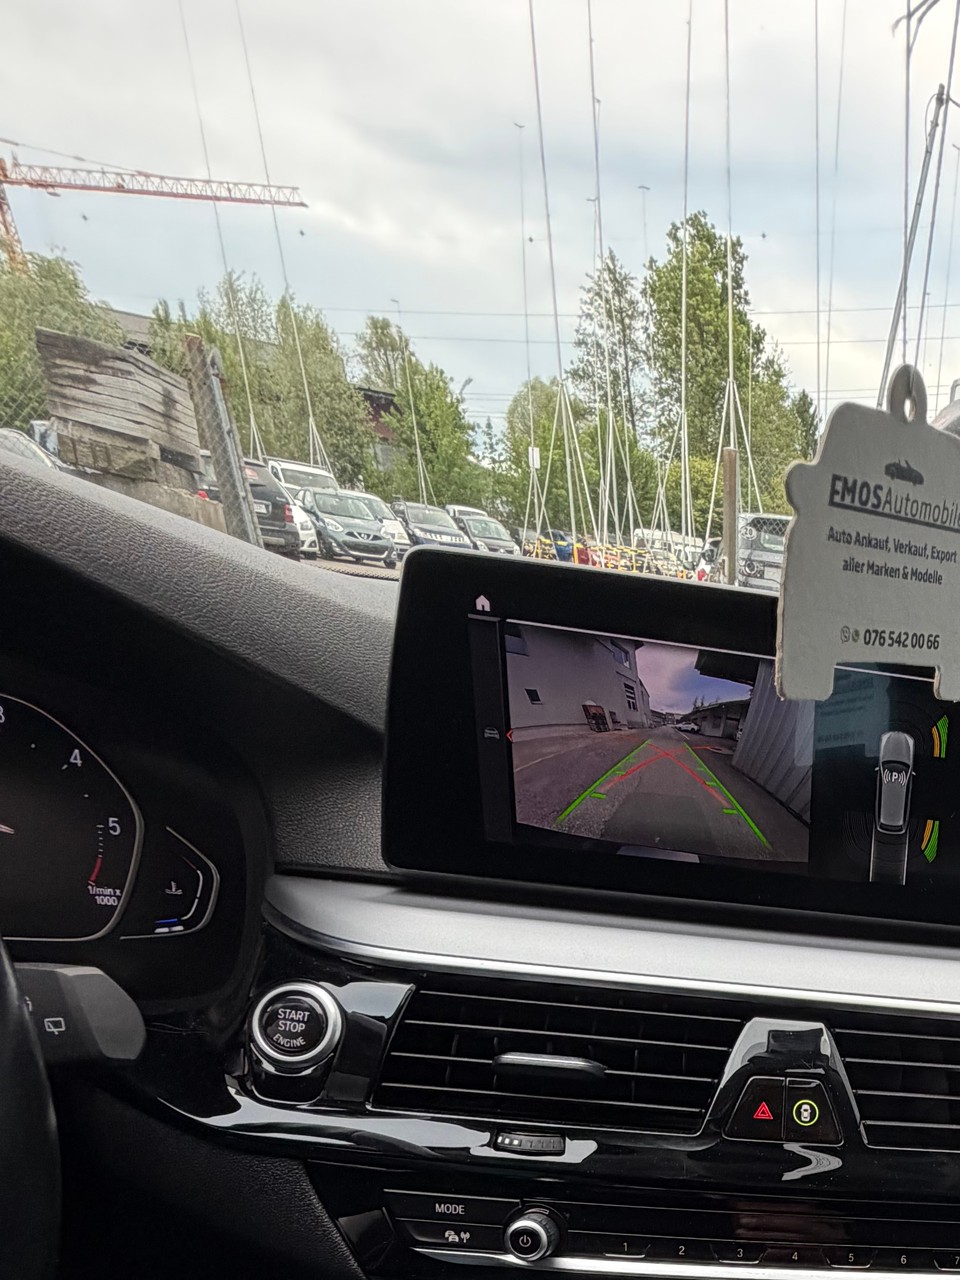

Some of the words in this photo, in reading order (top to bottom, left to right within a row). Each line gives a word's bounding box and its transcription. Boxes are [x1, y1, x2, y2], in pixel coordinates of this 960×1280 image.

[828, 526, 853, 545] Auto
[855, 531, 891, 553] Ankauf,
[893, 538, 929, 559] Verkauf,
[930, 546, 957, 564] Export
[842, 556, 865, 573] aller
[866, 560, 900, 579] Marken
[902, 566, 909, 580] &
[910, 567, 943, 585] Modelle
[864, 628, 886, 647] 076
[888, 630, 910, 648] 542
[911, 632, 925, 649] 00
[926, 634, 940, 650] 66
[69, 748, 83, 767] 4
[108, 817, 121, 836] 5
[95, 896, 118, 905] 1000
[278, 1008, 310, 1021] START
[278, 1020, 306, 1033] STOP
[272, 1033, 306, 1047] ENGINE
[435, 1203, 465, 1215] MODE
[622, 1242, 628, 1252] 1
[678, 1246, 685, 1255] 2
[737, 1248, 743, 1258] 3
[791, 1252, 798, 1261] 4
[848, 1253, 854, 1263] 5
[900, 1255, 907, 1265] 6
[954, 1256, 960, 1265] 7
